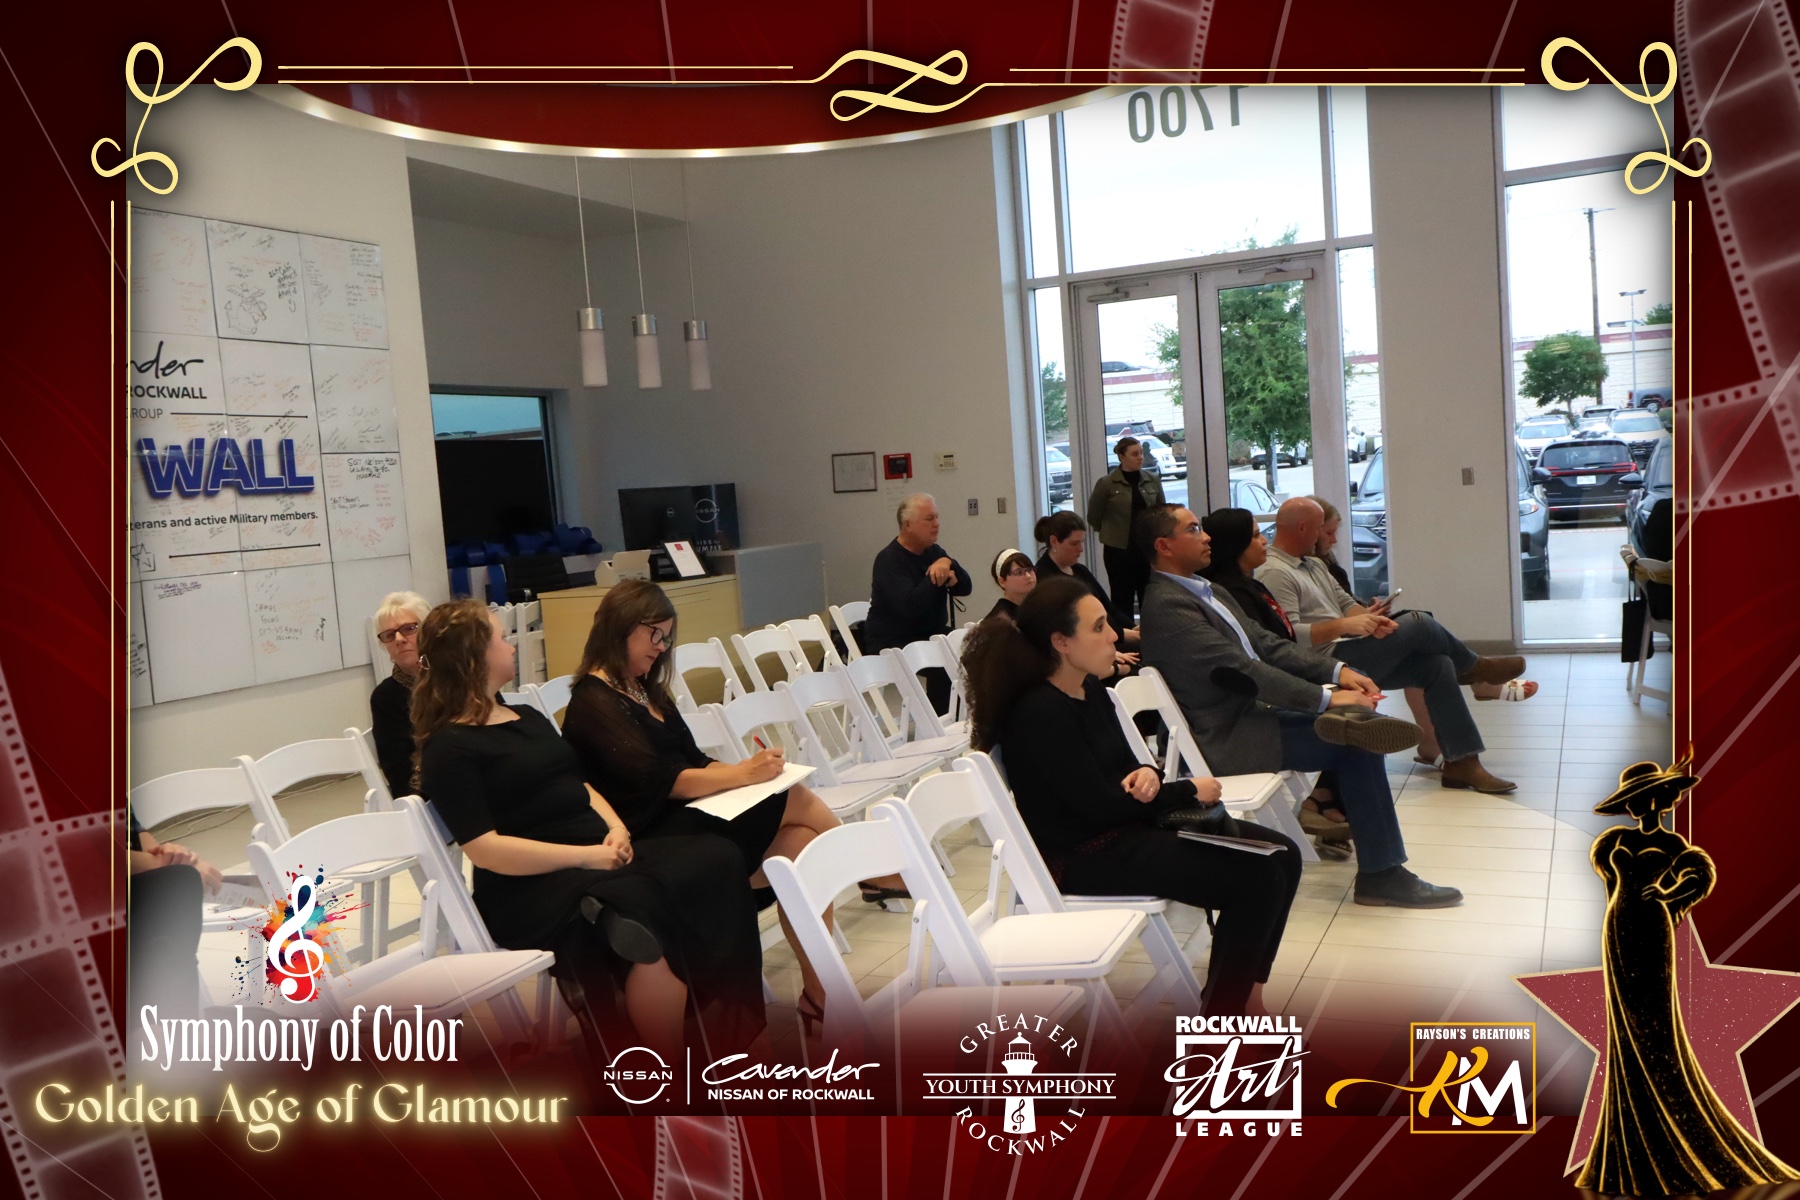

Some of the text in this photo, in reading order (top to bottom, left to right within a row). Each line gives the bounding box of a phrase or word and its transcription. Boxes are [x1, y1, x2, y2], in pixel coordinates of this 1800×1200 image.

[137, 437, 315, 499] WALL
[170, 516, 192, 528] and
[194, 514, 228, 526] active
[229, 512, 269, 525] Military
[270, 510, 319, 522] members.
